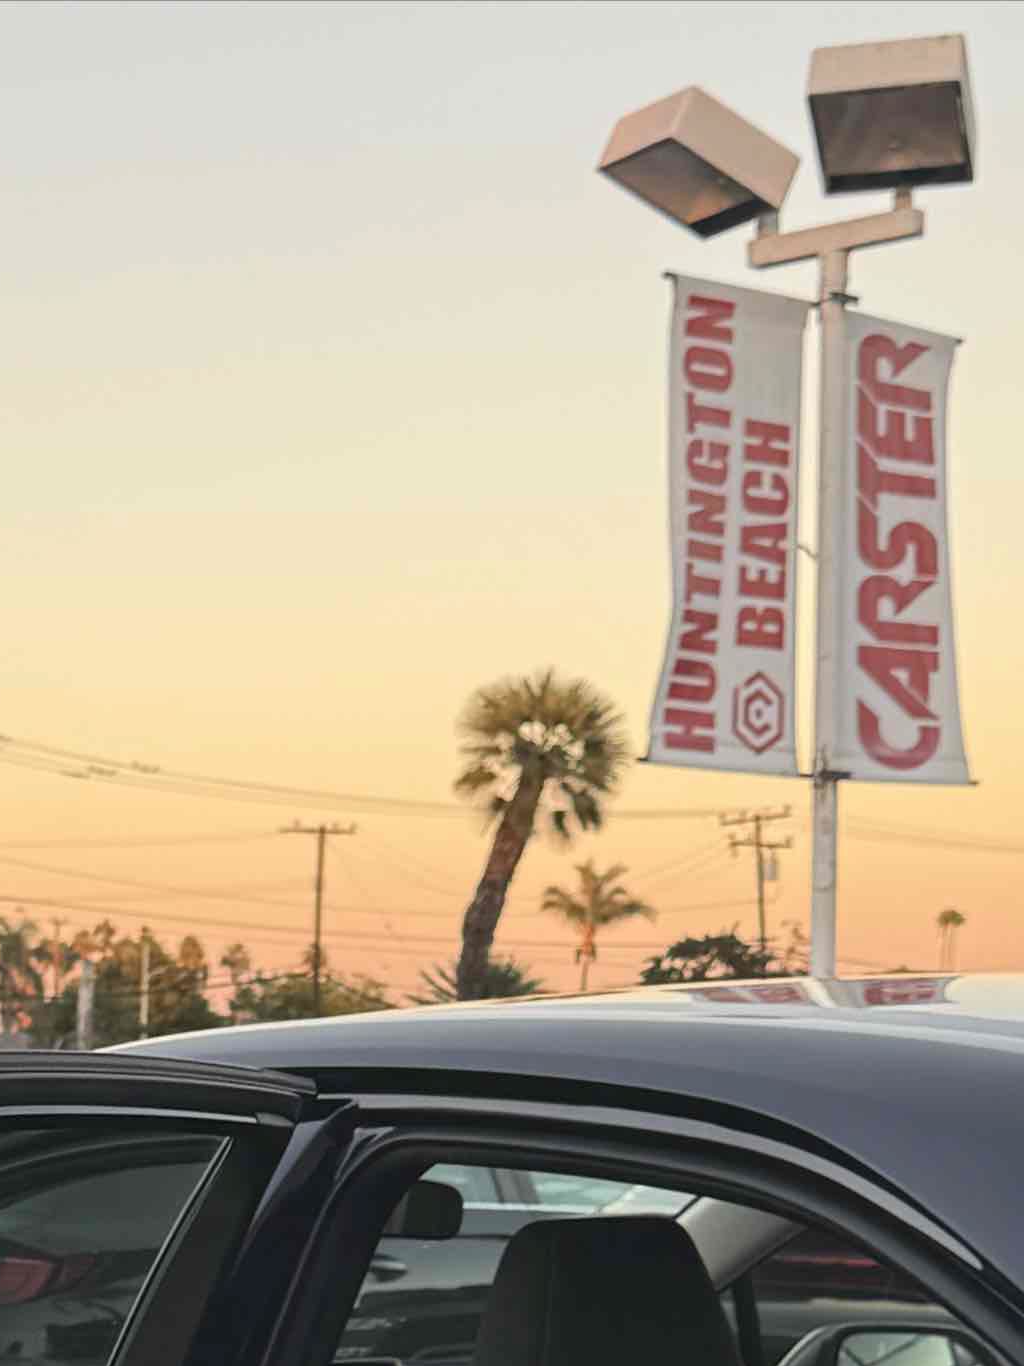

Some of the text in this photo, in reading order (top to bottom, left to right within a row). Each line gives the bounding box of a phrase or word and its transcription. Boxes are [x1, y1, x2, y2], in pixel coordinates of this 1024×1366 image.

[664, 295, 735, 754] HUNTINGTON
[735, 419, 790, 650] BEACH
[857, 333, 941, 770] CARSTER
